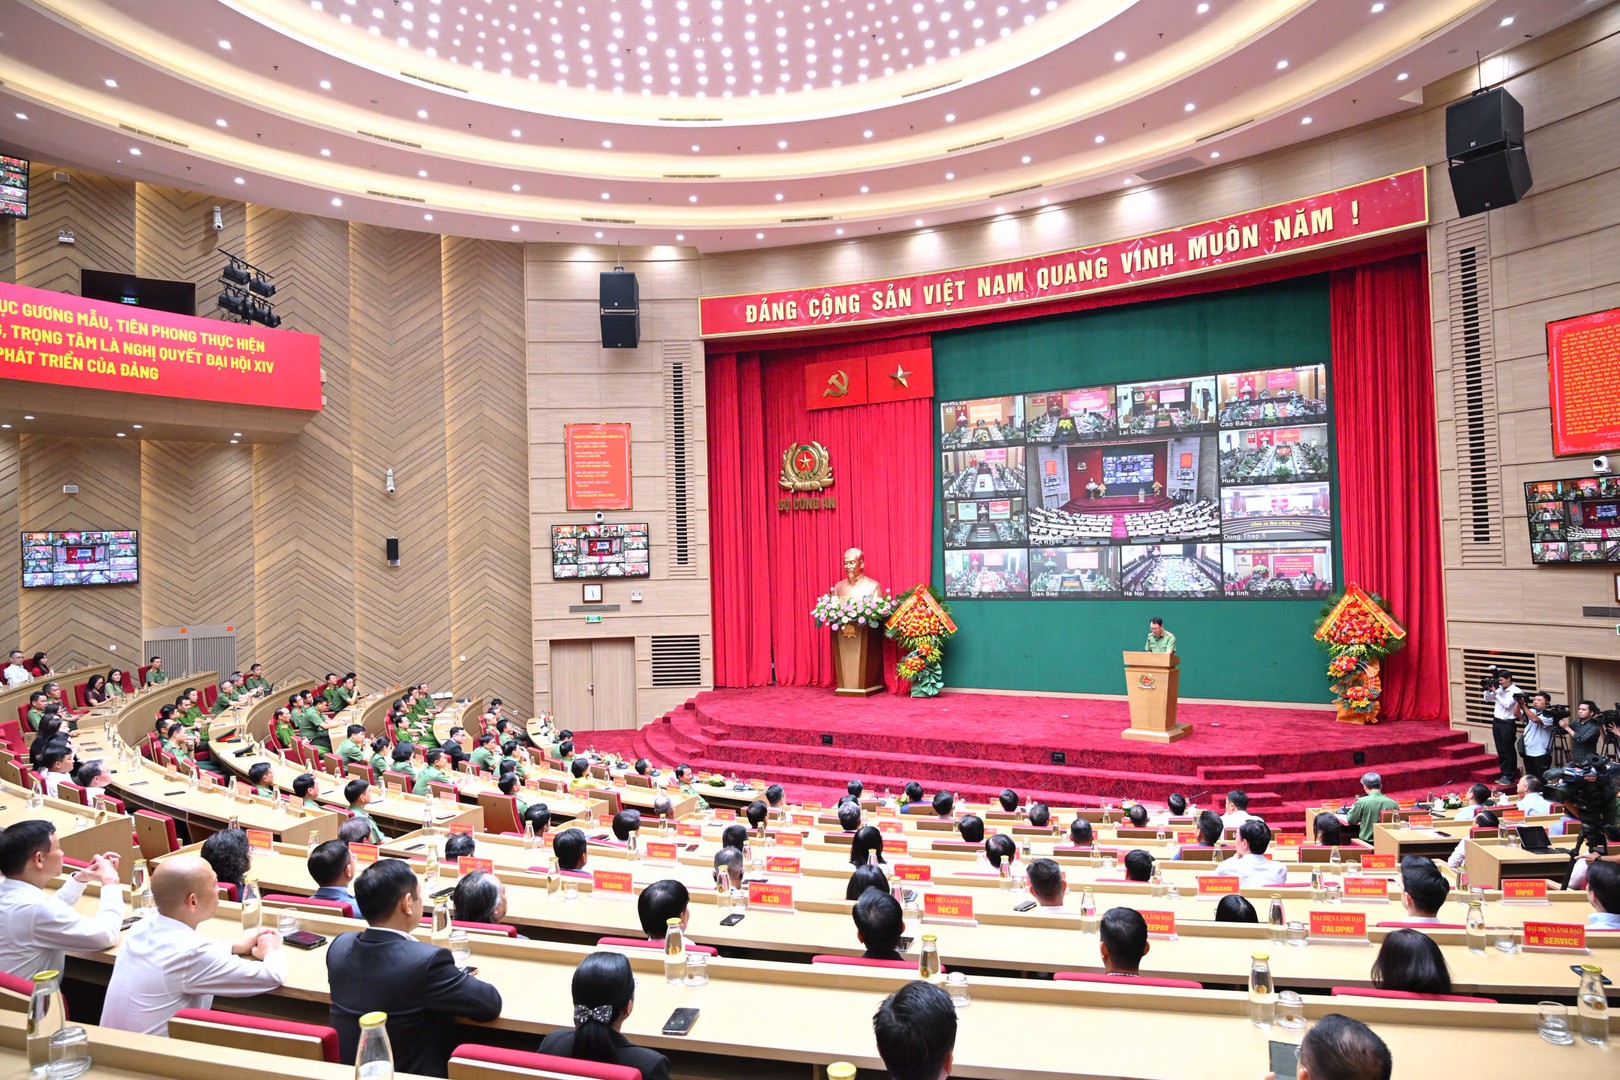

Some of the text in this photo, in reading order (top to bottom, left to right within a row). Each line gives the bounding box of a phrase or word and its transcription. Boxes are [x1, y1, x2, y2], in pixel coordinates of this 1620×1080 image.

[746, 298, 797, 323] ĐẢNG
[808, 293, 860, 320] CỘNG
[872, 283, 912, 310] SẢN
[923, 278, 966, 306] VIỆT
[977, 271, 1024, 298] NAM
[1037, 256, 1108, 291] QUANG
[1188, 224, 1259, 261] MUÔN
[1274, 208, 1334, 242] NĂM
[1350, 200, 1361, 225] !
[22, 303, 74, 324] GƯƠNG
[77, 308, 113, 332] MẪU,
[116, 318, 149, 336] TIÊN
[151, 324, 197, 343] PHONG
[200, 331, 234, 350] THỰC
[236, 337, 265, 355] HIỆN
[10, 324, 63, 346] TRỌNG
[66, 332, 98, 350] TÂM
[100, 336, 120, 353] LÀ
[123, 341, 157, 362] NGHỊ
[159, 347, 203, 365] QUYẾT
[206, 353, 228, 371] ĐẠI
[230, 356, 252, 374] HỘI
[254, 359, 275, 373] XIV
[39, 350, 84, 371] TRIỂN
[87, 356, 117, 375] CỦA
[120, 361, 159, 380] ĐẢNG
[823, 496, 836, 509] AN
[762, 894, 779, 903] SCB
[938, 905, 959, 915] NCB
[1321, 925, 1355, 933] ZALOPAY
